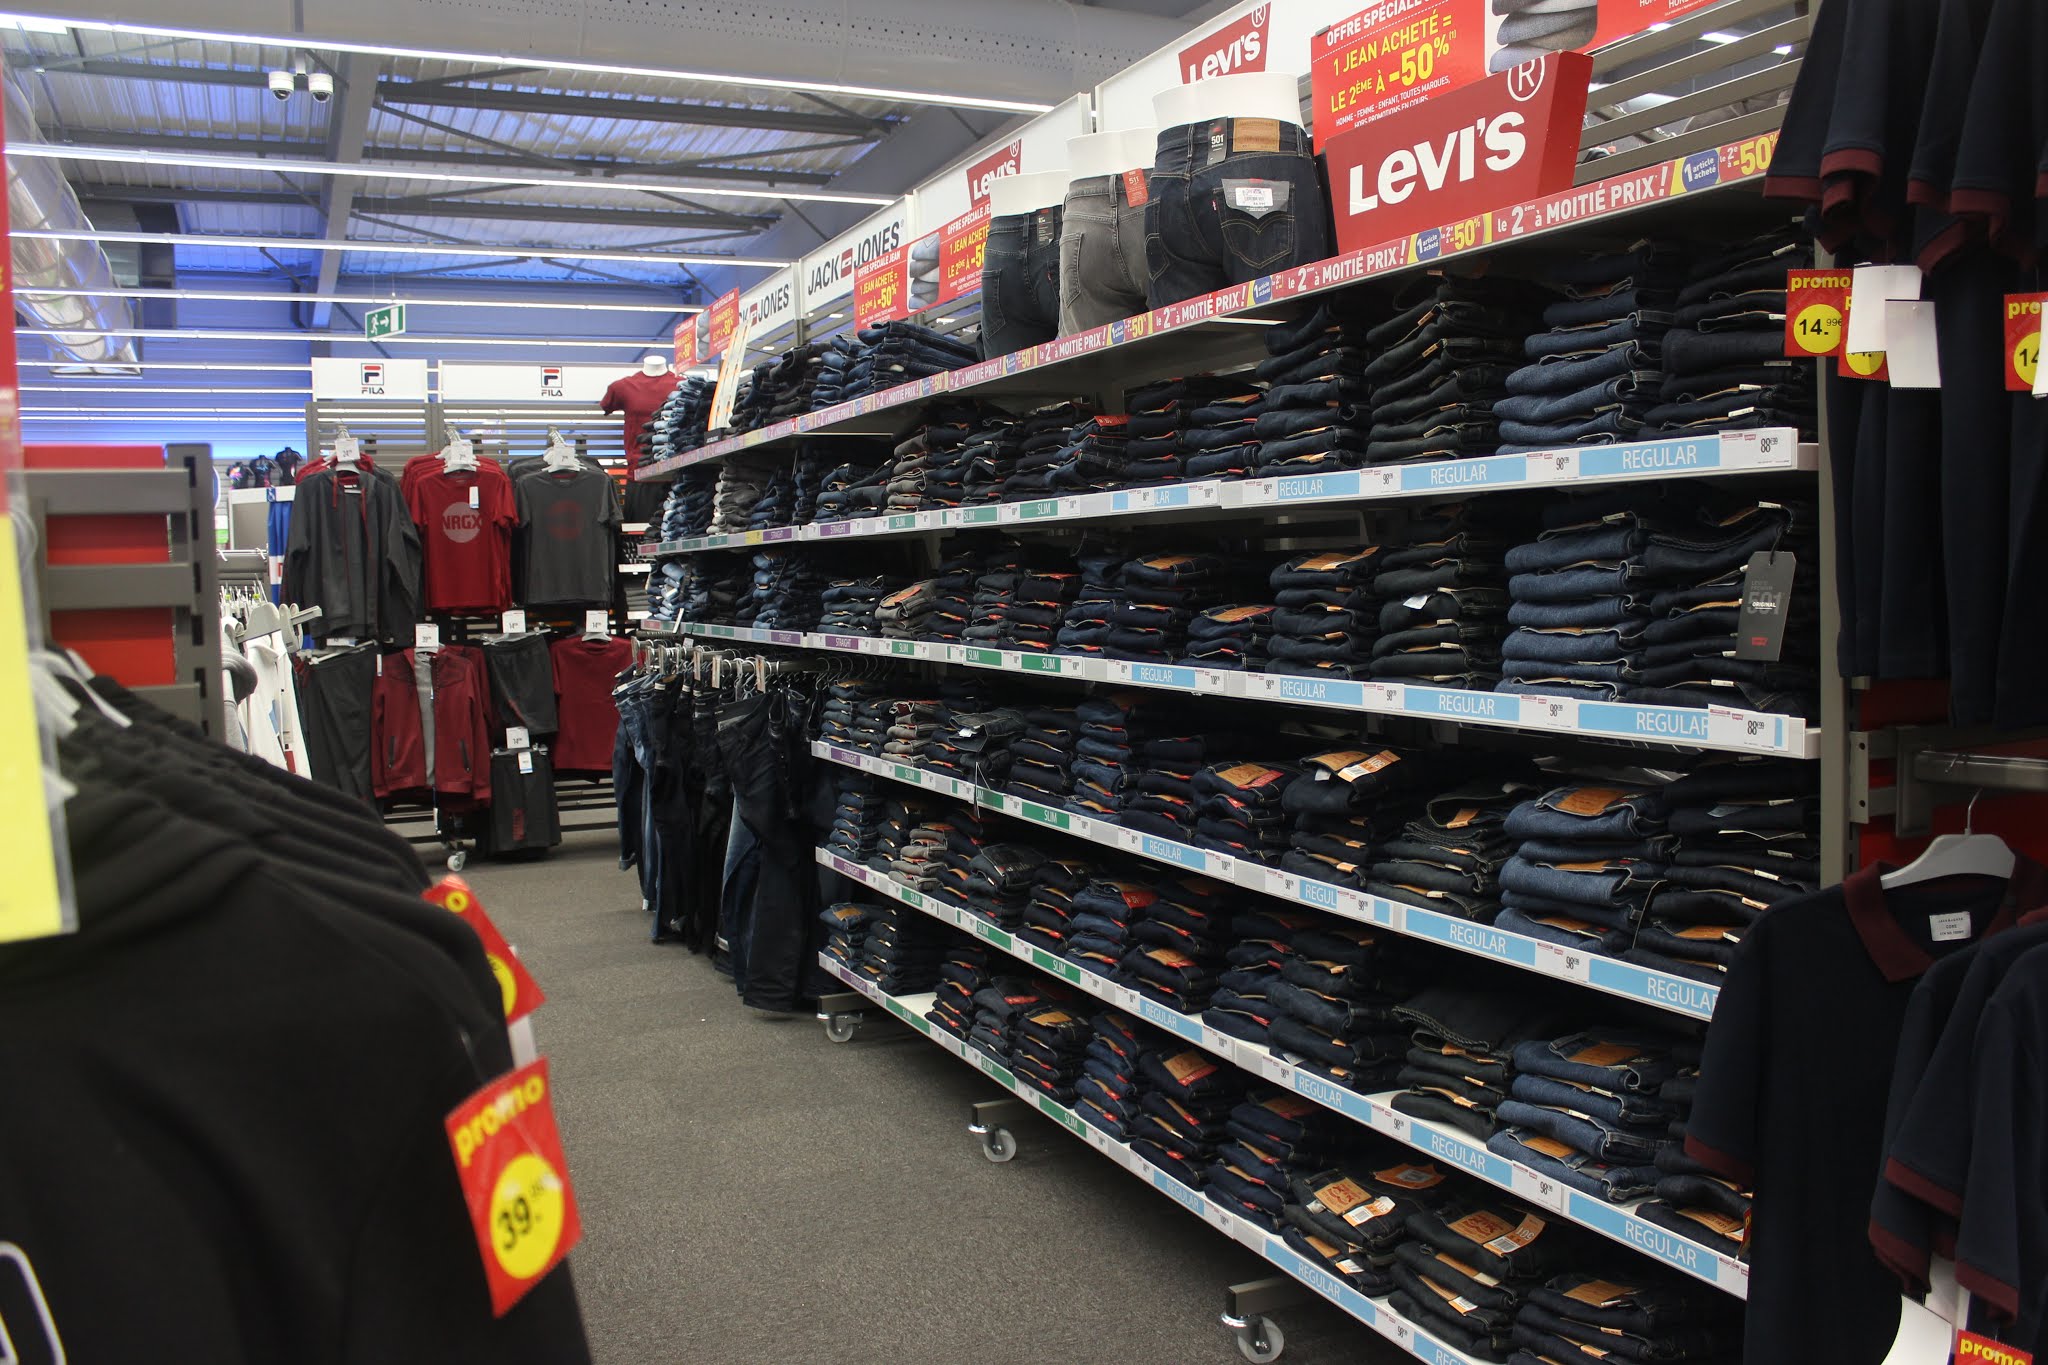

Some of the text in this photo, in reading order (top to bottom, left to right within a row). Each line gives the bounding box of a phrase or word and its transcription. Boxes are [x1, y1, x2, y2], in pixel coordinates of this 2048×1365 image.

[1327, 17, 1361, 46] OFFRE
[1333, 58, 1339, 76] 1
[1343, 41, 1377, 72] JEAN
[1381, 9, 1439, 56] ACHETÉ
[1331, 90, 1346, 113] LE
[1375, 70, 1385, 94] À
[1693, 157, 1714, 173] article
[1694, 164, 1716, 180] acheté
[1497, 218, 1507, 233] le
[1535, 211, 1542, 227] à
[1546, 183, 1606, 224] MOITIÉ
[808, 221, 899, 296] JACK JONES
[1288, 278, 1295, 290] le
[1314, 273, 1320, 286] à
[1322, 250, 1363, 284] MOITIÉ
[1791, 276, 1850, 292] promo
[759, 283, 789, 323] JONES
[1156, 315, 1162, 326] le
[1182, 294, 1213, 323] MOITIÉ
[1059, 333, 1082, 357] MOITIÉ
[361, 387, 384, 395] FILA
[541, 389, 563, 397] FILA
[1622, 445, 1697, 470] REGULAR
[1431, 464, 1487, 485] REGULAR
[1279, 478, 1323, 497] REGULAR
[963, 511, 975, 522] SLIM
[1037, 503, 1051, 515] SLIM
[967, 649, 980, 661] SLIM
[1042, 657, 1056, 670] SLIM
[1140, 667, 1173, 683] REGULAR
[1282, 681, 1326, 699] REGULAR
[1438, 694, 1495, 716] REGULAR
[904, 768, 915, 781] SLIM
[1044, 809, 1058, 824] SLIM
[1149, 840, 1182, 861] REGULAR
[1305, 884, 1336, 906] REGUL
[977, 922, 989, 937] SLIM
[1450, 923, 1507, 955] REGULAR
[1052, 960, 1066, 975] SLIM
[1145, 1003, 1177, 1029] REGULAR
[982, 1058, 994, 1073] SLIM
[1299, 1074, 1342, 1107] REGULAR
[454, 1075, 545, 1167] promo
[1064, 1113, 1078, 1130] SLIM
[1432, 1134, 1486, 1170] REGULAR
[1166, 1184, 1200, 1210] REGULAR
[1625, 1220, 1697, 1269] REGULAR
[1298, 1262, 1341, 1301] REGULAR
